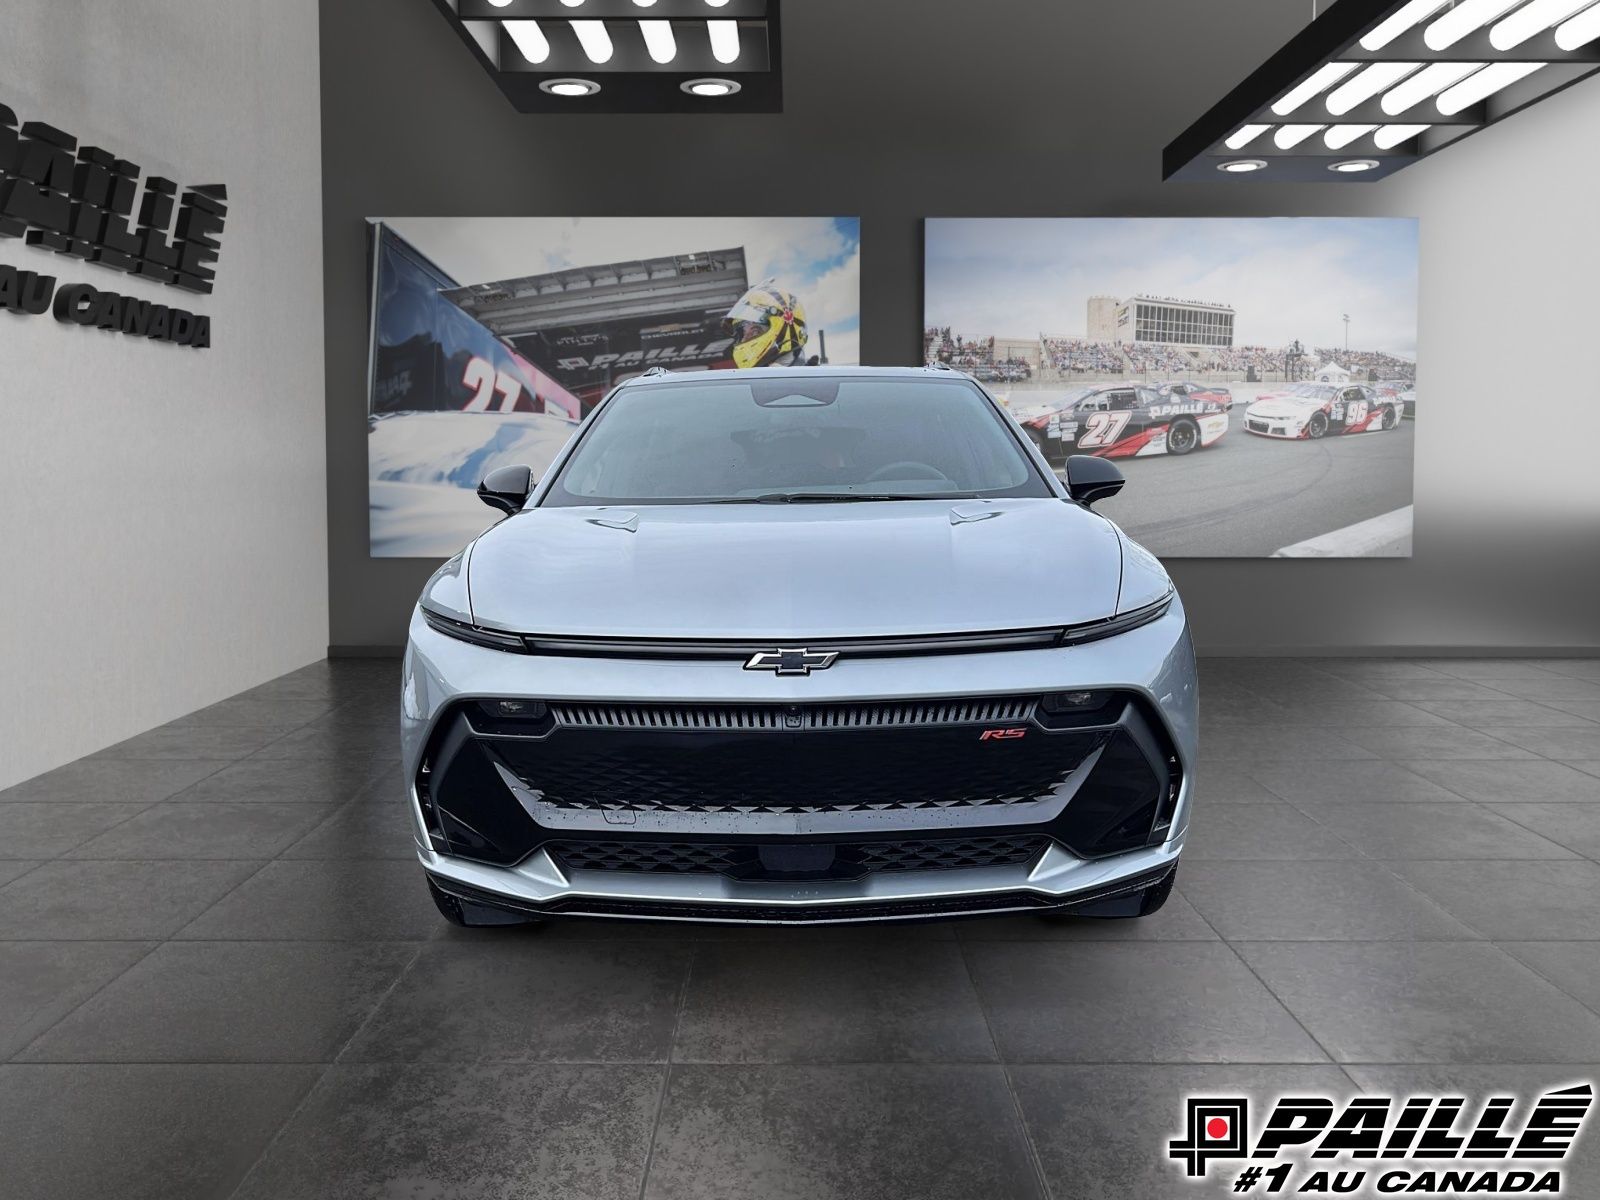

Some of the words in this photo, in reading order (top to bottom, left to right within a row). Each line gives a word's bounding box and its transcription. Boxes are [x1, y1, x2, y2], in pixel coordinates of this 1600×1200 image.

[0, 103, 228, 294] AILLÉ
[53, 283, 210, 348] CANADA
[462, 356, 522, 413] 27
[1077, 410, 1133, 449] 27
[1345, 400, 1368, 426] 96
[979, 727, 1027, 740] RS
